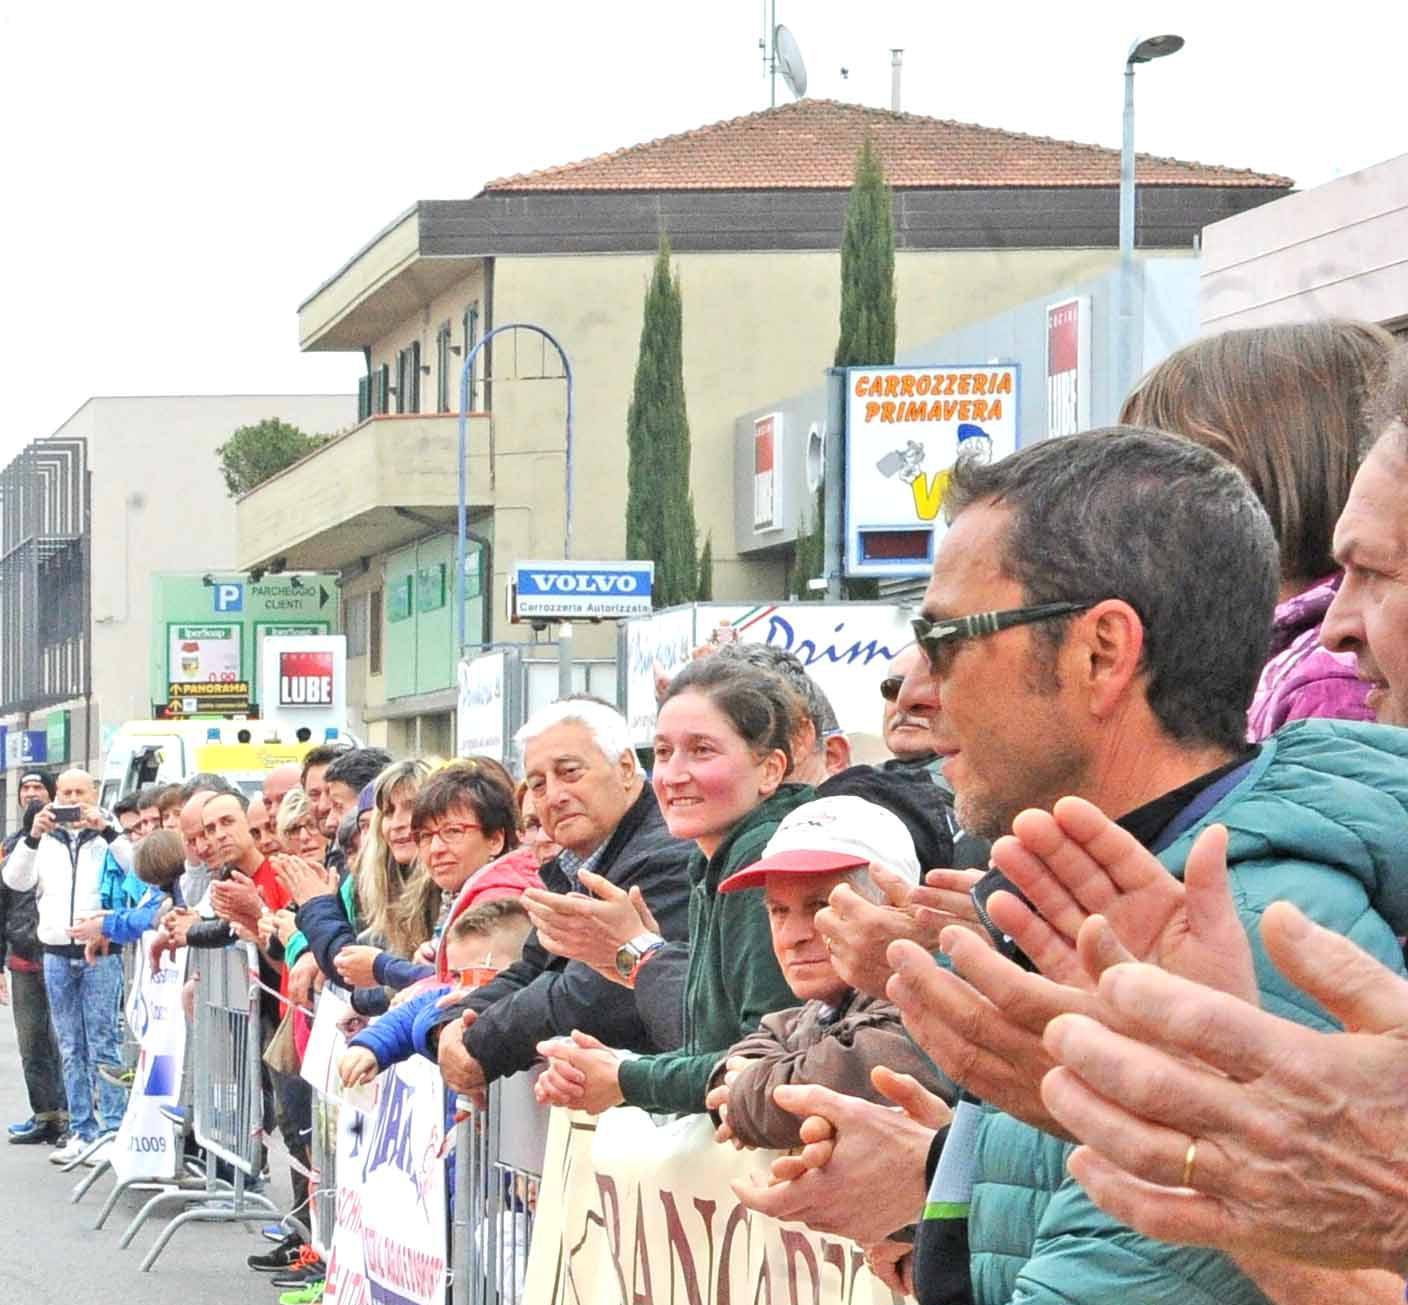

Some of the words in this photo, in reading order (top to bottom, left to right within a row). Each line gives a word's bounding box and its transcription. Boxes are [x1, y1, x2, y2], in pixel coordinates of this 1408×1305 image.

[855, 372, 1013, 398] CARROZZERIA
[865, 399, 1002, 424] PRIMAVERA
[252, 586, 316, 597] PARCHEGGIO
[531, 574, 638, 592] VOLVO
[220, 586, 239, 609] P
[265, 600, 303, 610] CLIENTI
[520, 602, 582, 613] Carrozzeria
[184, 683, 248, 694] PANORAMA
[281, 676, 331, 703] LUBE
